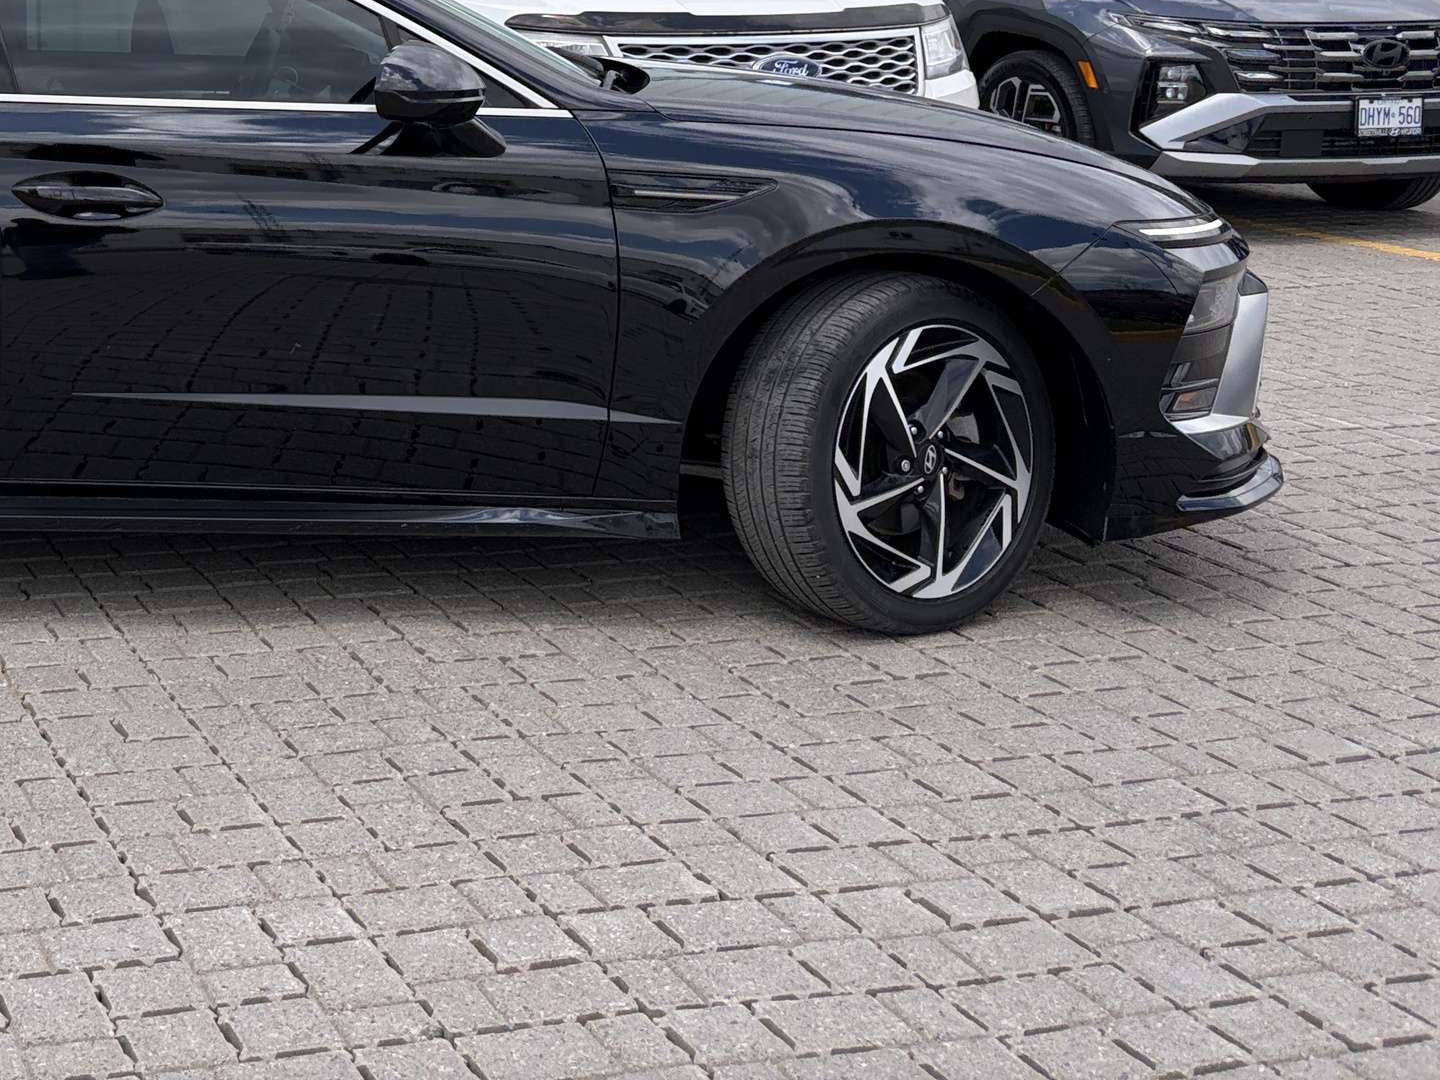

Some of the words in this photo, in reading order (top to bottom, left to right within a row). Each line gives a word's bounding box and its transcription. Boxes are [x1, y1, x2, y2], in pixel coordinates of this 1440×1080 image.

[772, 60, 809, 77] Ford
[1359, 106, 1391, 127] DHYM
[1398, 105, 1421, 125] 560
